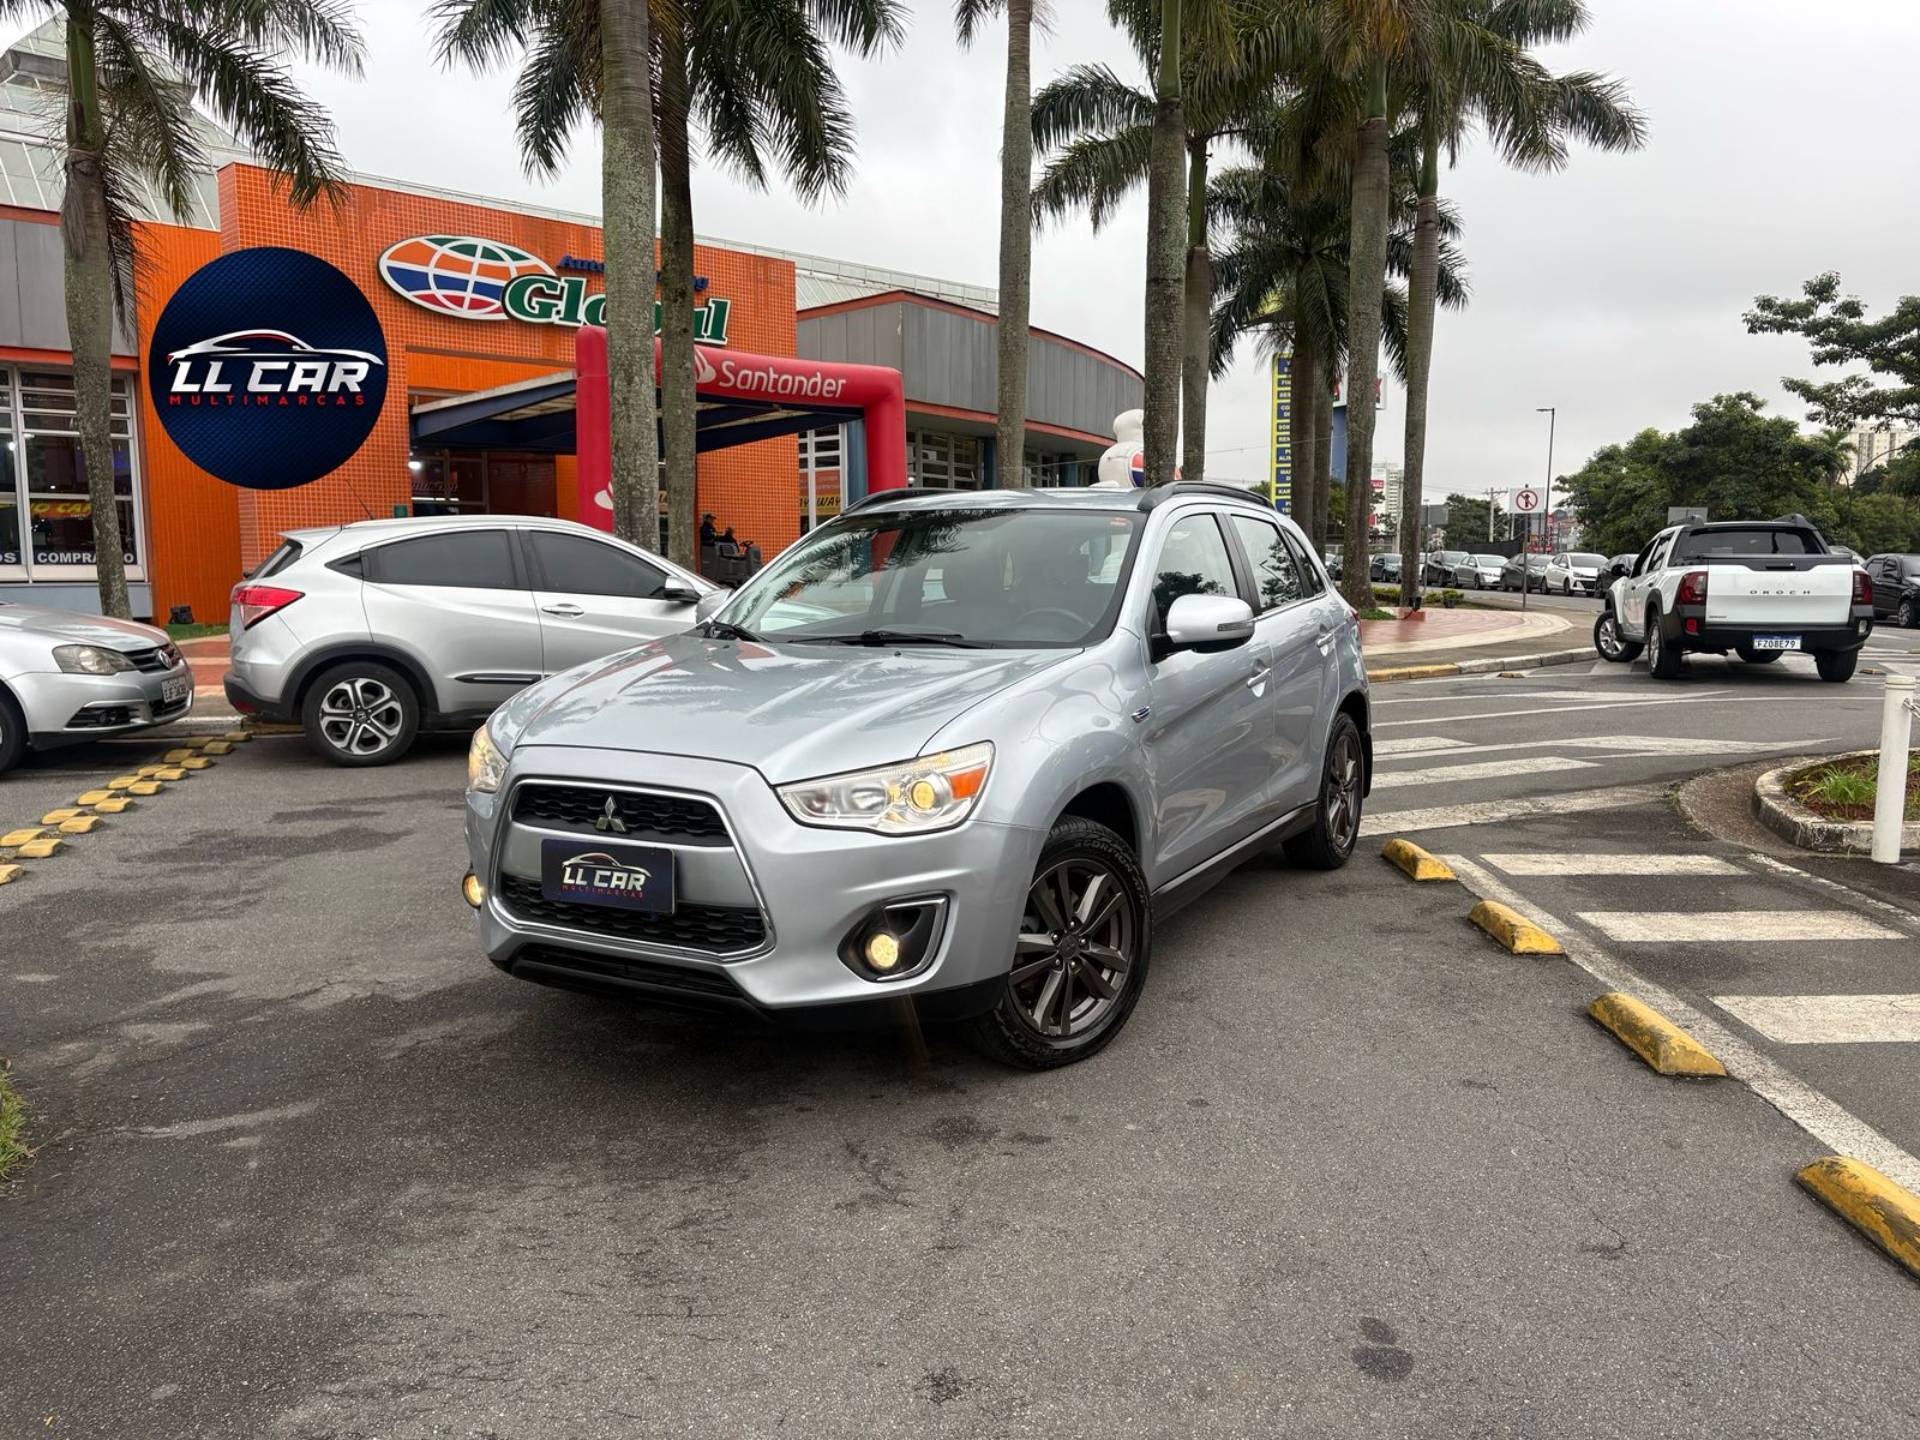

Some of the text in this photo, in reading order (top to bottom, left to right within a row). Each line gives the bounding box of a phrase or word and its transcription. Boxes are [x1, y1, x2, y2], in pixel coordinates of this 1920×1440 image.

[718, 360, 847, 399] Santander
[562, 884, 644, 898] MULTIMARCAS
[563, 866, 646, 891] LL CAR
